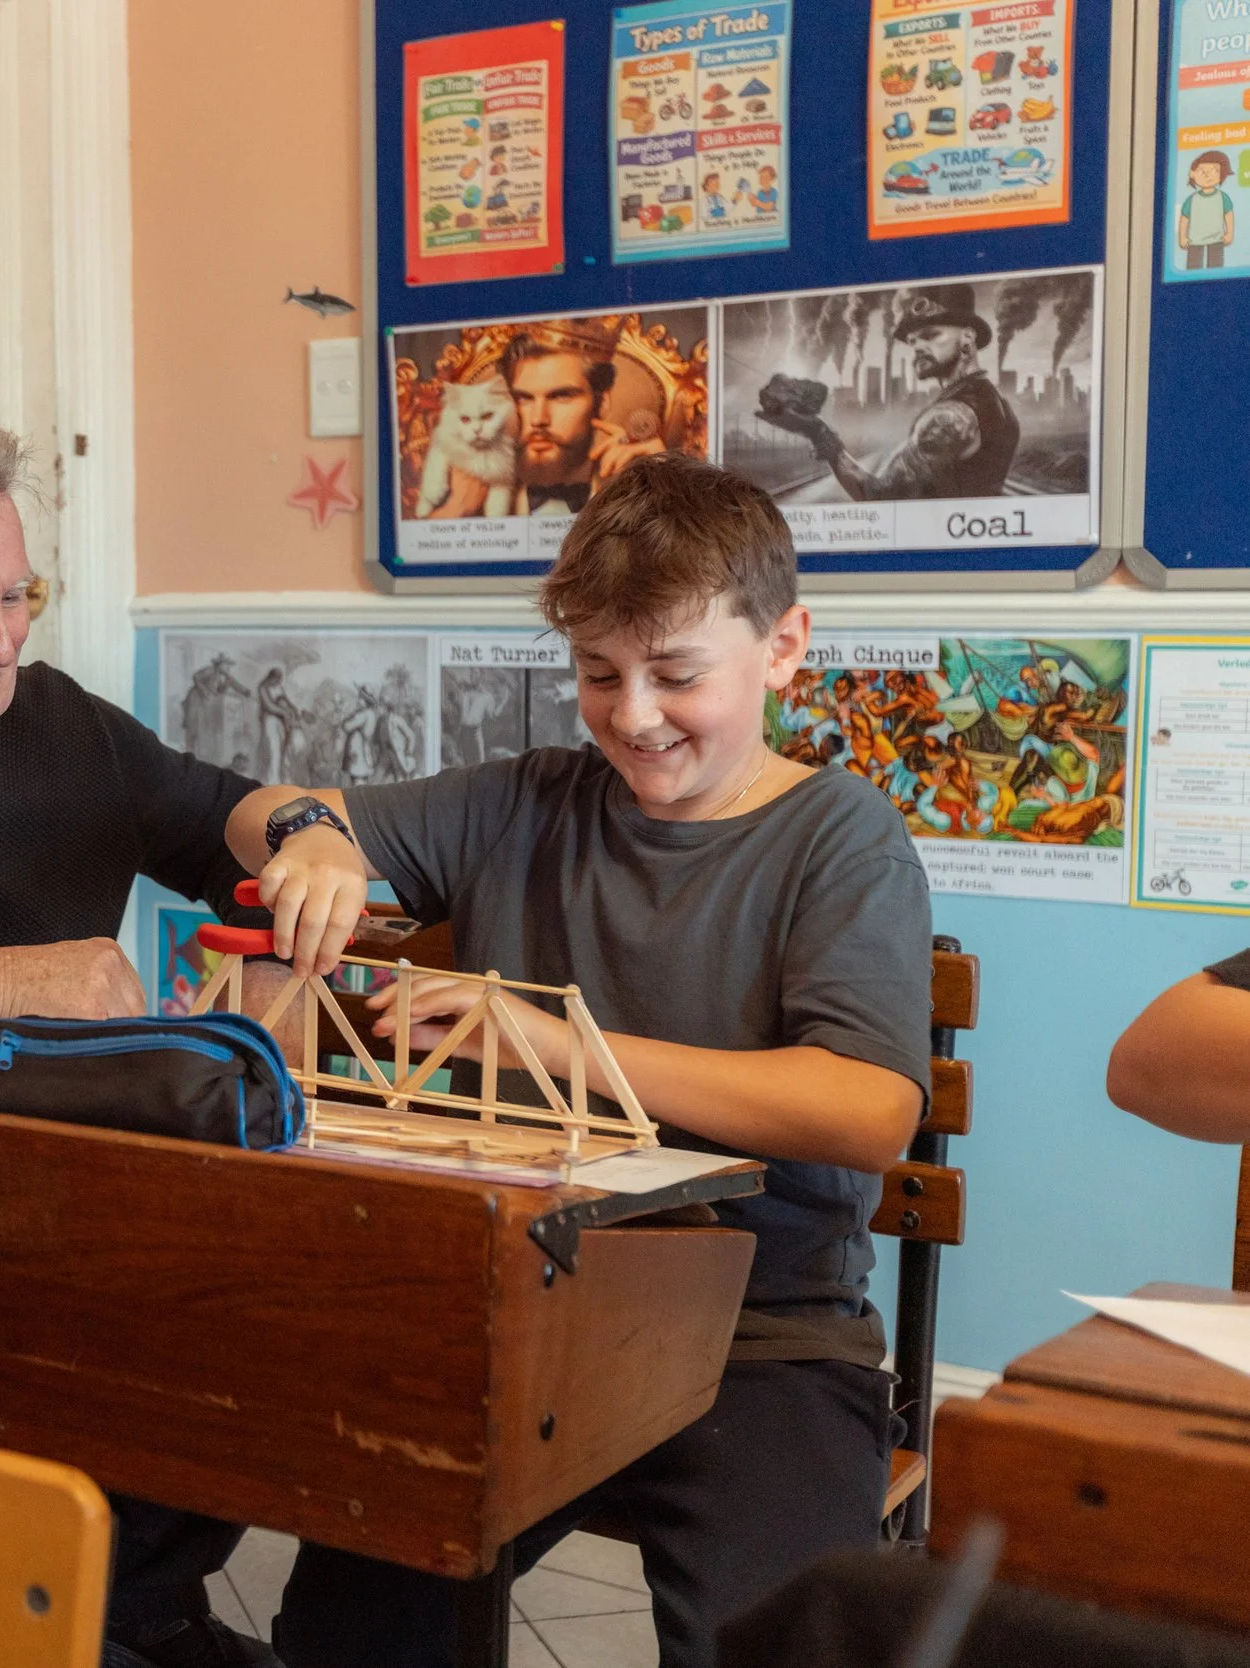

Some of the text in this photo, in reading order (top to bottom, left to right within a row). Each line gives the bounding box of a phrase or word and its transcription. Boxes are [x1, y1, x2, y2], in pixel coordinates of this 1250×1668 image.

[1206, 0, 1250, 21] Wh
[630, 9, 769, 52] Types of Trade
[1019, 21, 1040, 33] BUY
[928, 33, 949, 45] SELL
[636, 55, 675, 75] Goods
[1193, 69, 1237, 83] Jealous
[980, 86, 1012, 97] Clothing
[701, 132, 727, 148] Skills
[735, 128, 777, 143] Services
[1182, 126, 1247, 143] Feeling bad
[620, 132, 692, 156] Manufactured
[940, 148, 991, 166] TRADE
[939, 165, 992, 181] Around the
[925, 201, 951, 211] Travel
[953, 197, 990, 208] Between
[461, 522, 471, 533] of
[476, 521, 506, 532] value
[946, 510, 1033, 540] Coal
[456, 539, 467, 550] of
[471, 538, 520, 551] exchange
[451, 643, 561, 663] Nat Turner
[805, 643, 934, 668] eph Cinque
[922, 842, 1120, 864] successful revolt aboard the
[992, 865, 1015, 876] won
[1020, 866, 1056, 878] court
[932, 877, 946, 889] to
